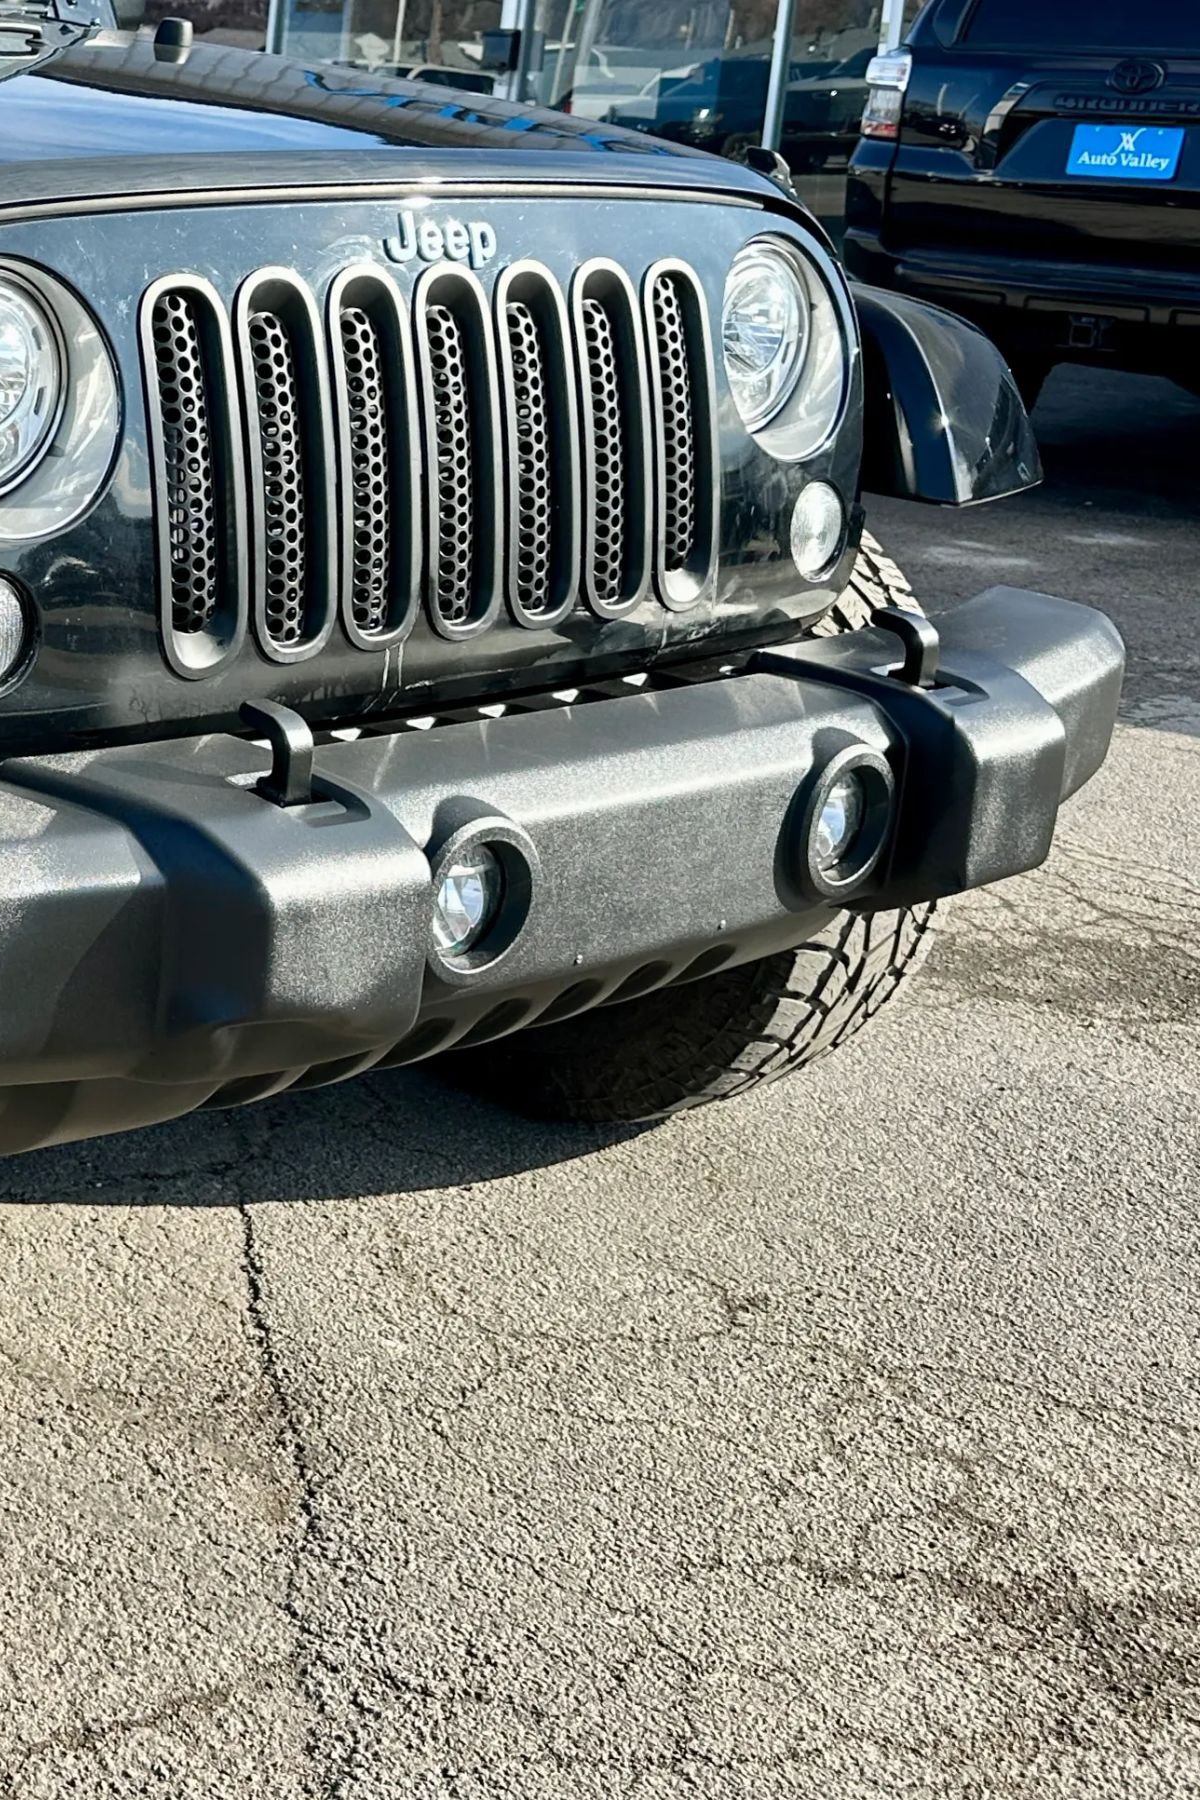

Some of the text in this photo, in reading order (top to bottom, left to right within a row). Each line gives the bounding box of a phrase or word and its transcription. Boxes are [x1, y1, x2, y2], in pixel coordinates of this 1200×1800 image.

[1077, 151, 1170, 171] Auto Valley
[382, 209, 497, 270] Jeep
